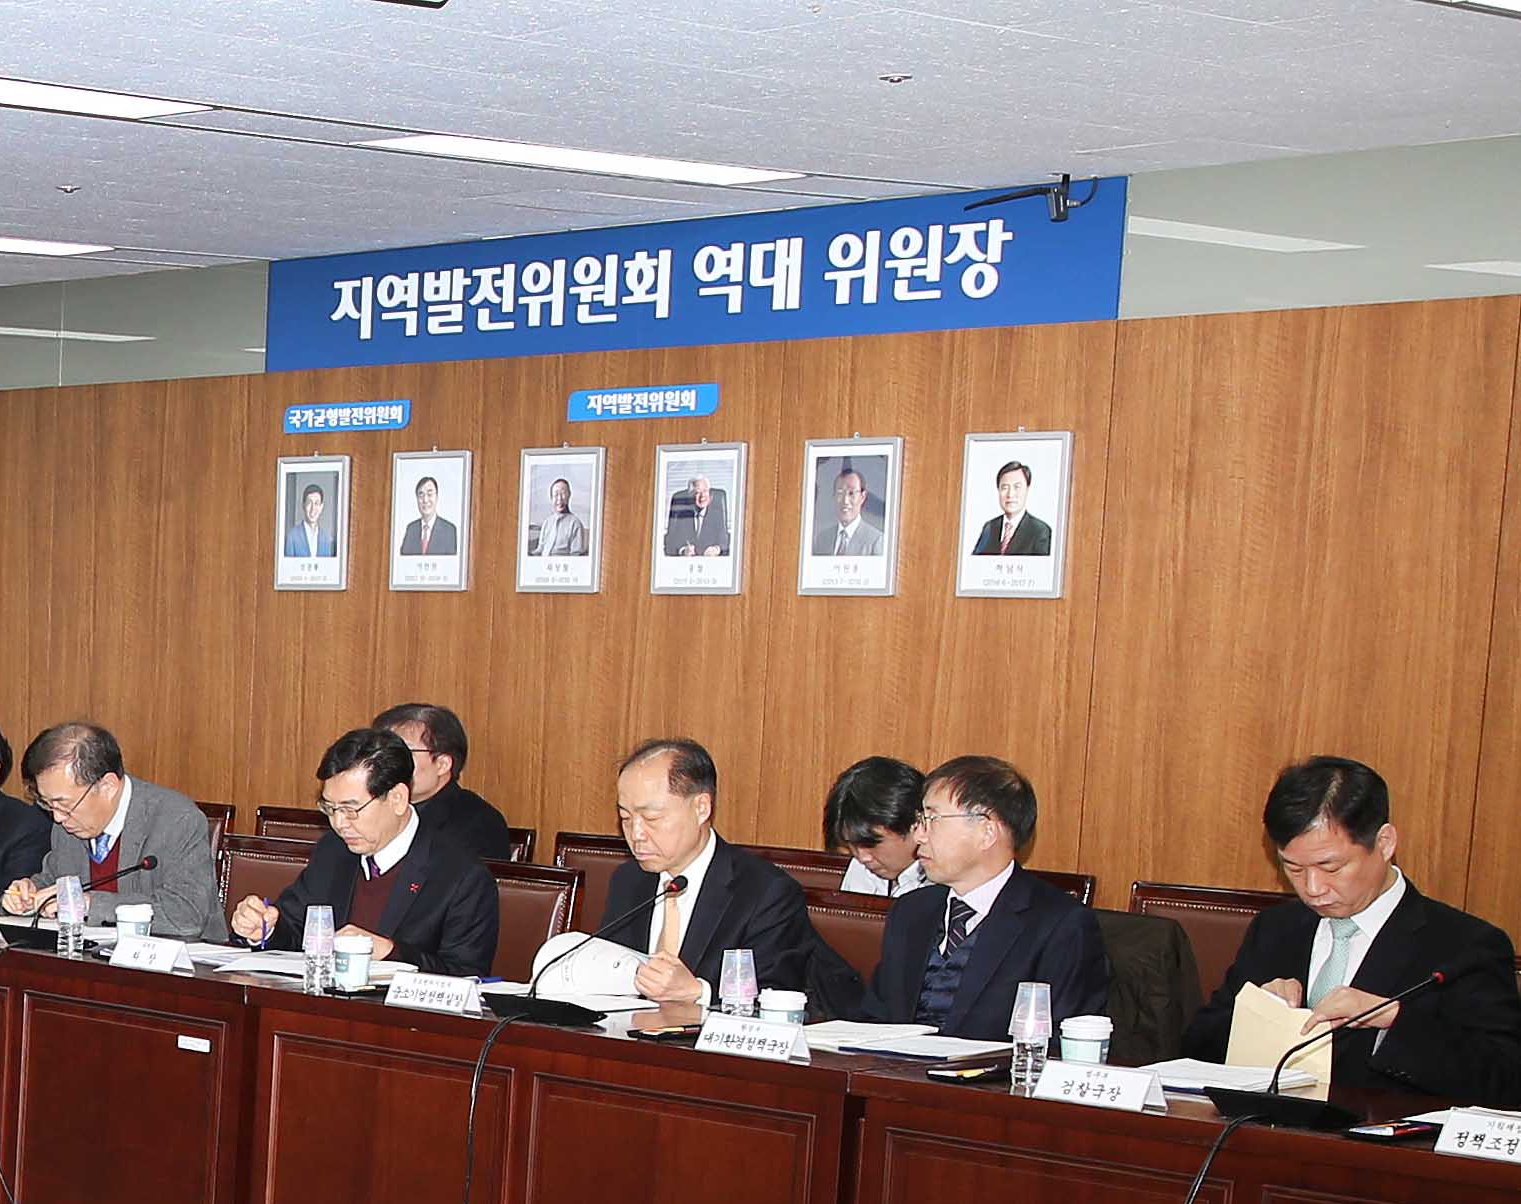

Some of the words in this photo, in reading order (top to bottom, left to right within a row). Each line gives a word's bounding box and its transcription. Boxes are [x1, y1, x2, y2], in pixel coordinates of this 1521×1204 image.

[331, 249, 671, 339] 지역발전위원회
[692, 236, 804, 315] 역대
[823, 218, 1014, 306] 위원장
[586, 390, 697, 412] 지역발전위원회
[287, 404, 404, 429] 국가균형발전위원회
[703, 1031, 789, 1055] 대기환경정책국장
[1060, 1080, 1122, 1102] 검찰국장
